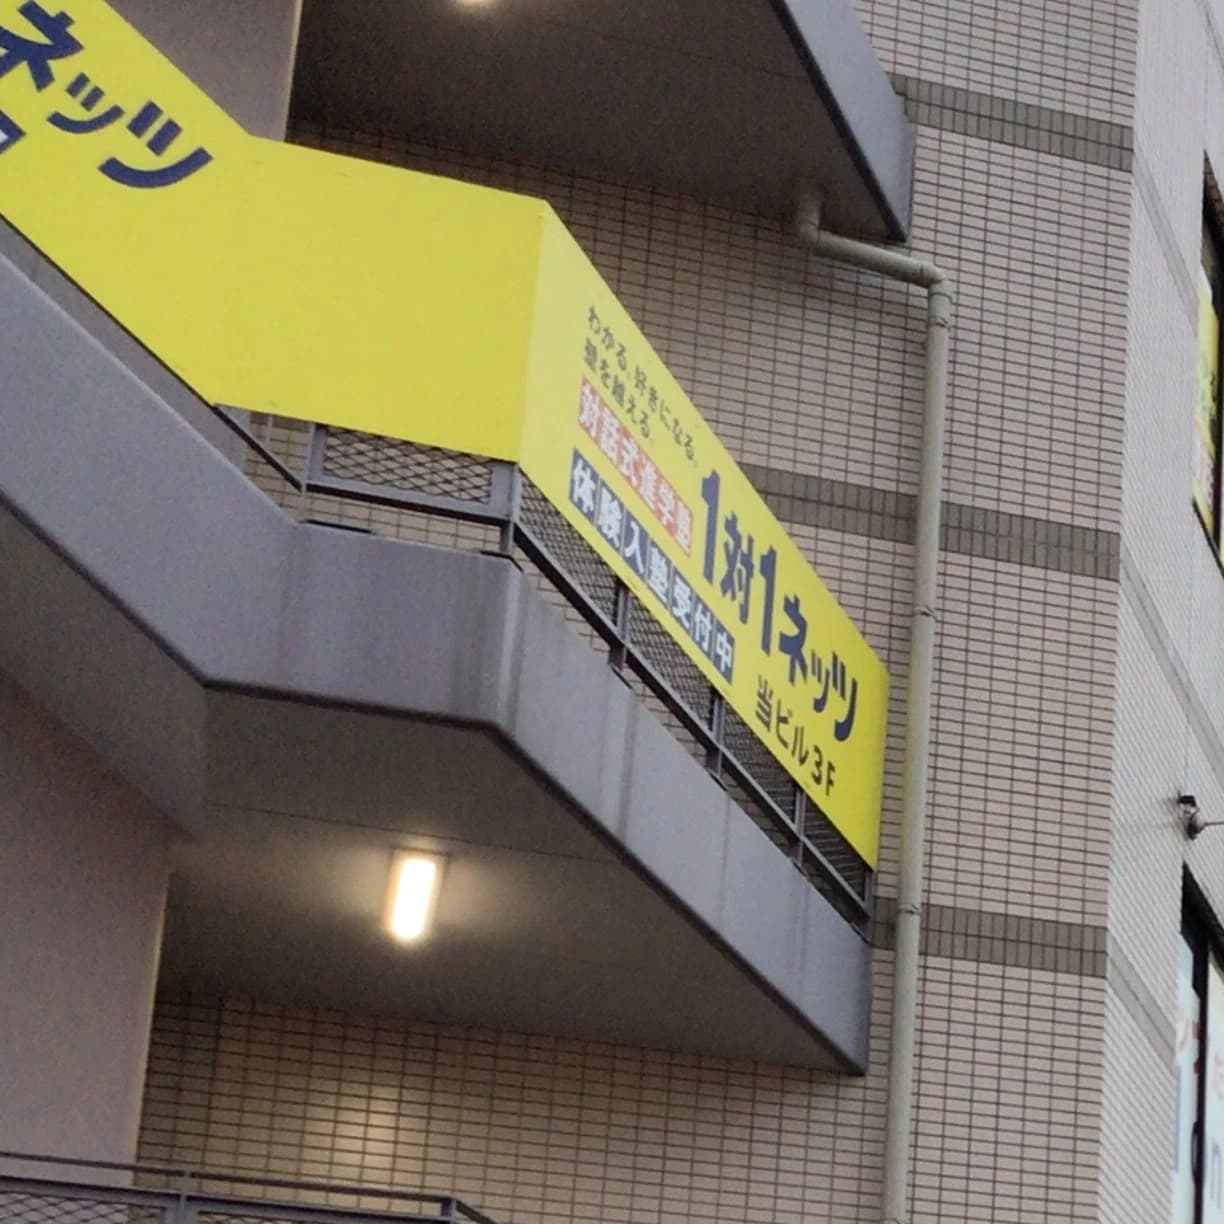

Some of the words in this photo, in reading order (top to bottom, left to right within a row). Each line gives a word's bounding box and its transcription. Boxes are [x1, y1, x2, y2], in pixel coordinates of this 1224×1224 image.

[571, 456, 733, 675] 体験入塾受付中
[701, 468, 858, 742] 1対1ネッツ
[755, 674, 836, 797] 当ビル3F
